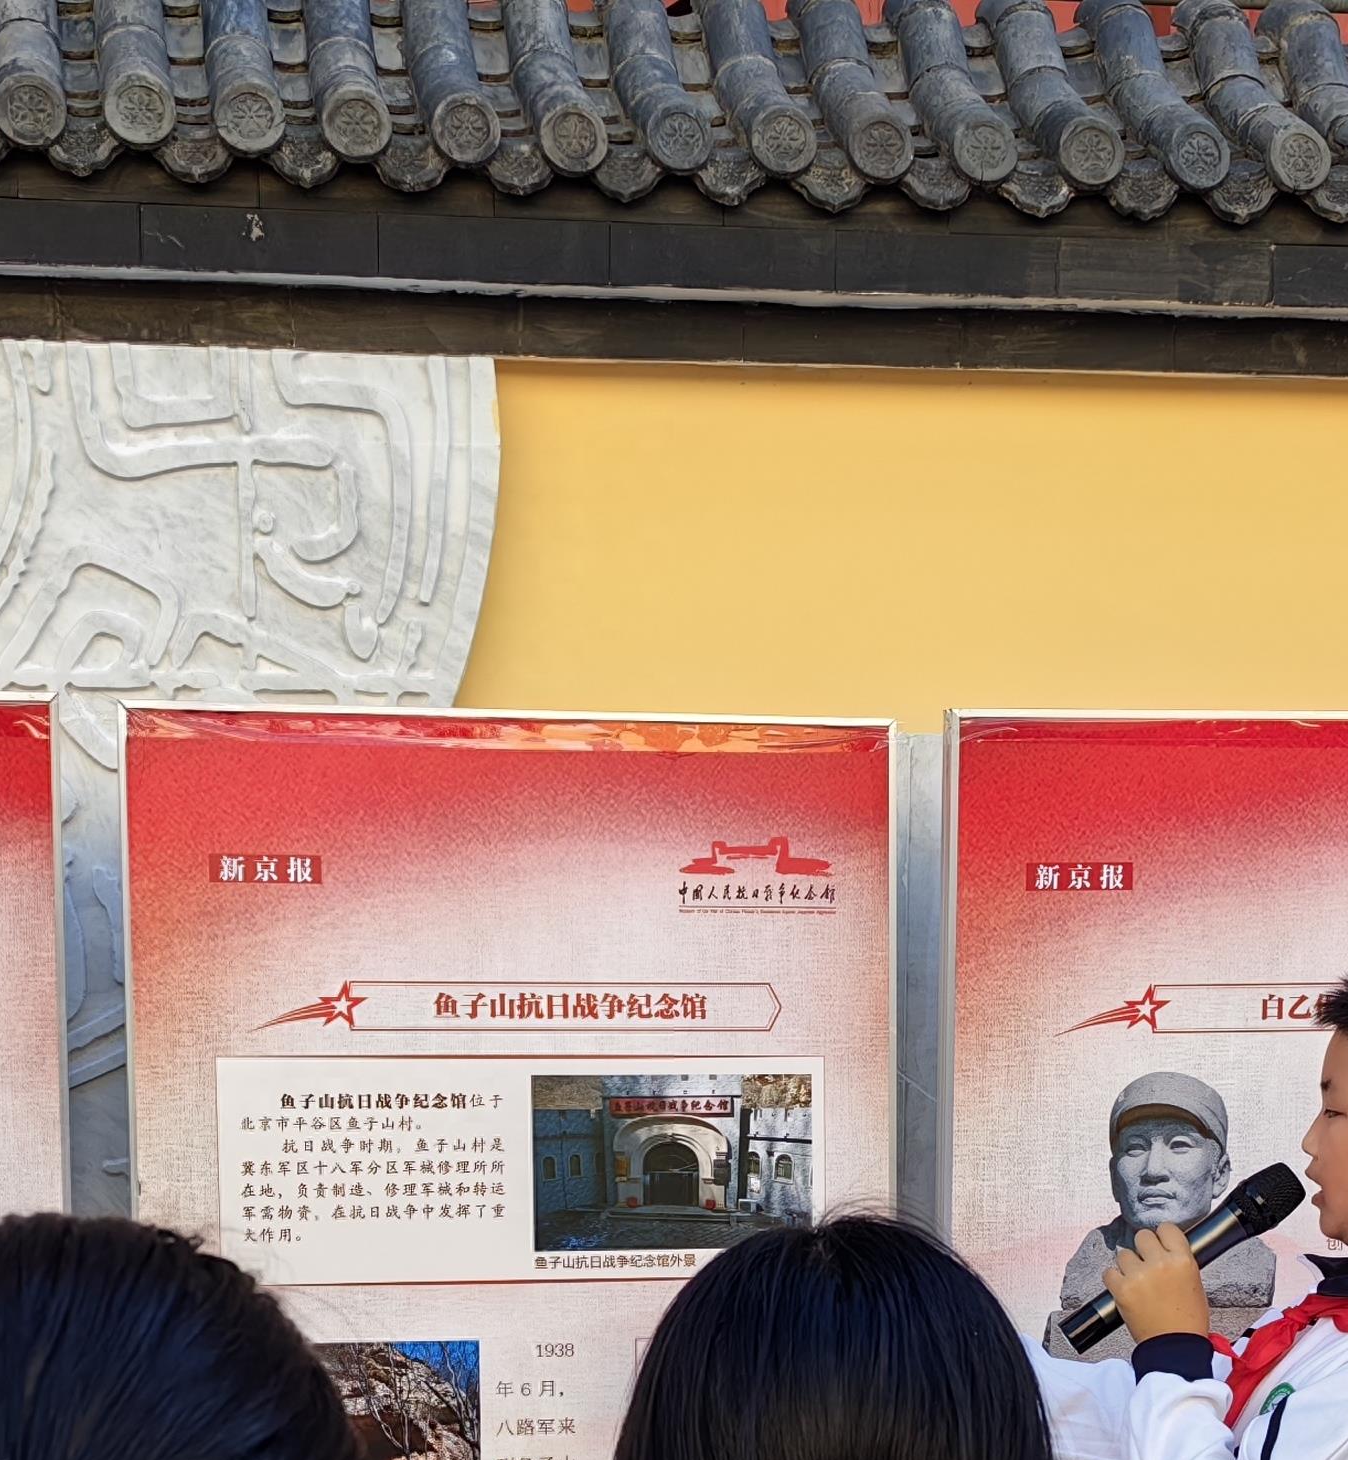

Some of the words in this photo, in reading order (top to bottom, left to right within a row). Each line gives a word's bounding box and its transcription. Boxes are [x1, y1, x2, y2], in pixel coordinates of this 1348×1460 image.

[218, 855, 314, 882] 新京报
[1035, 865, 1126, 890] 新京报
[433, 992, 708, 1021] 鱼子山抗日战争纪念馆
[280, 1092, 505, 1110] 鱼子山抗日战争纪念馆位于
[240, 1115, 423, 1133] 北京市平谷区鱼子山村。
[282, 1137, 506, 1155] 抗日战争时期，鱼子山村是
[243, 1226, 303, 1243] 大作用。
[534, 1253, 697, 1270] 鱼子山抗日战争纪念馆外景
[536, 1343, 576, 1358] 1938
[496, 1417, 577, 1436] 八路军来
